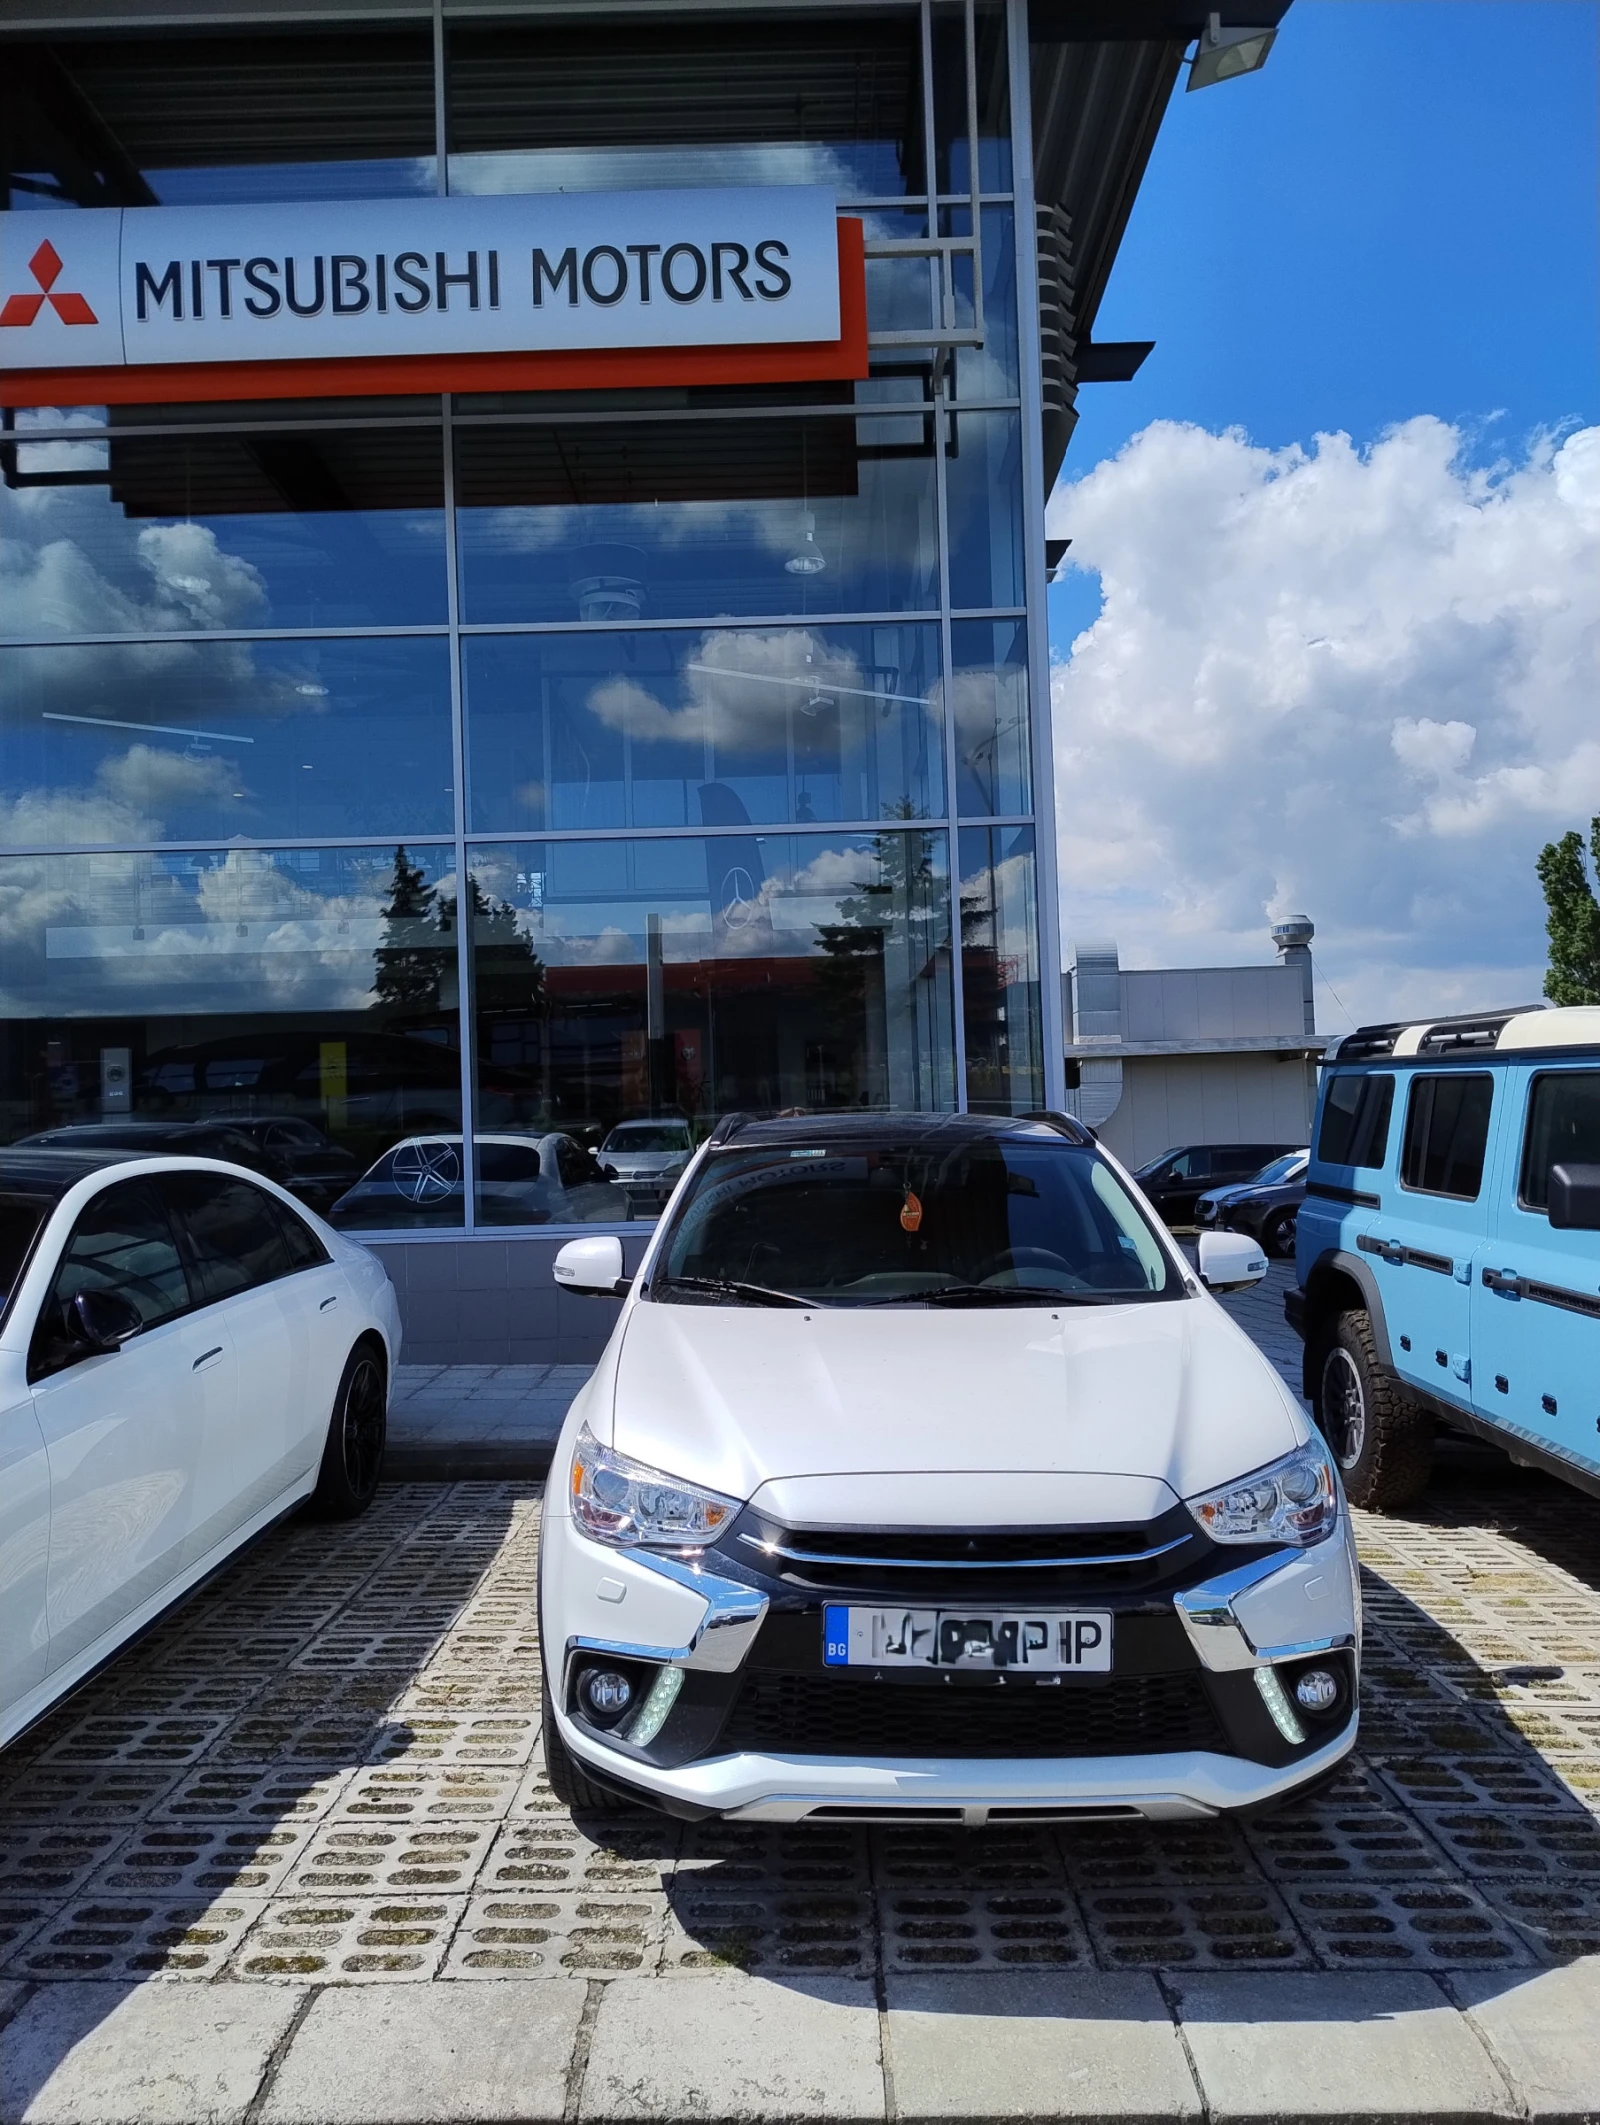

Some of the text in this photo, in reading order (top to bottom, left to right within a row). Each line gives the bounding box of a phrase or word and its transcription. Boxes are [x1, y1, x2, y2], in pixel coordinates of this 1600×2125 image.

[136, 240, 793, 322] MITSUBISHI MOTORS
[828, 1642, 847, 1657] BG
